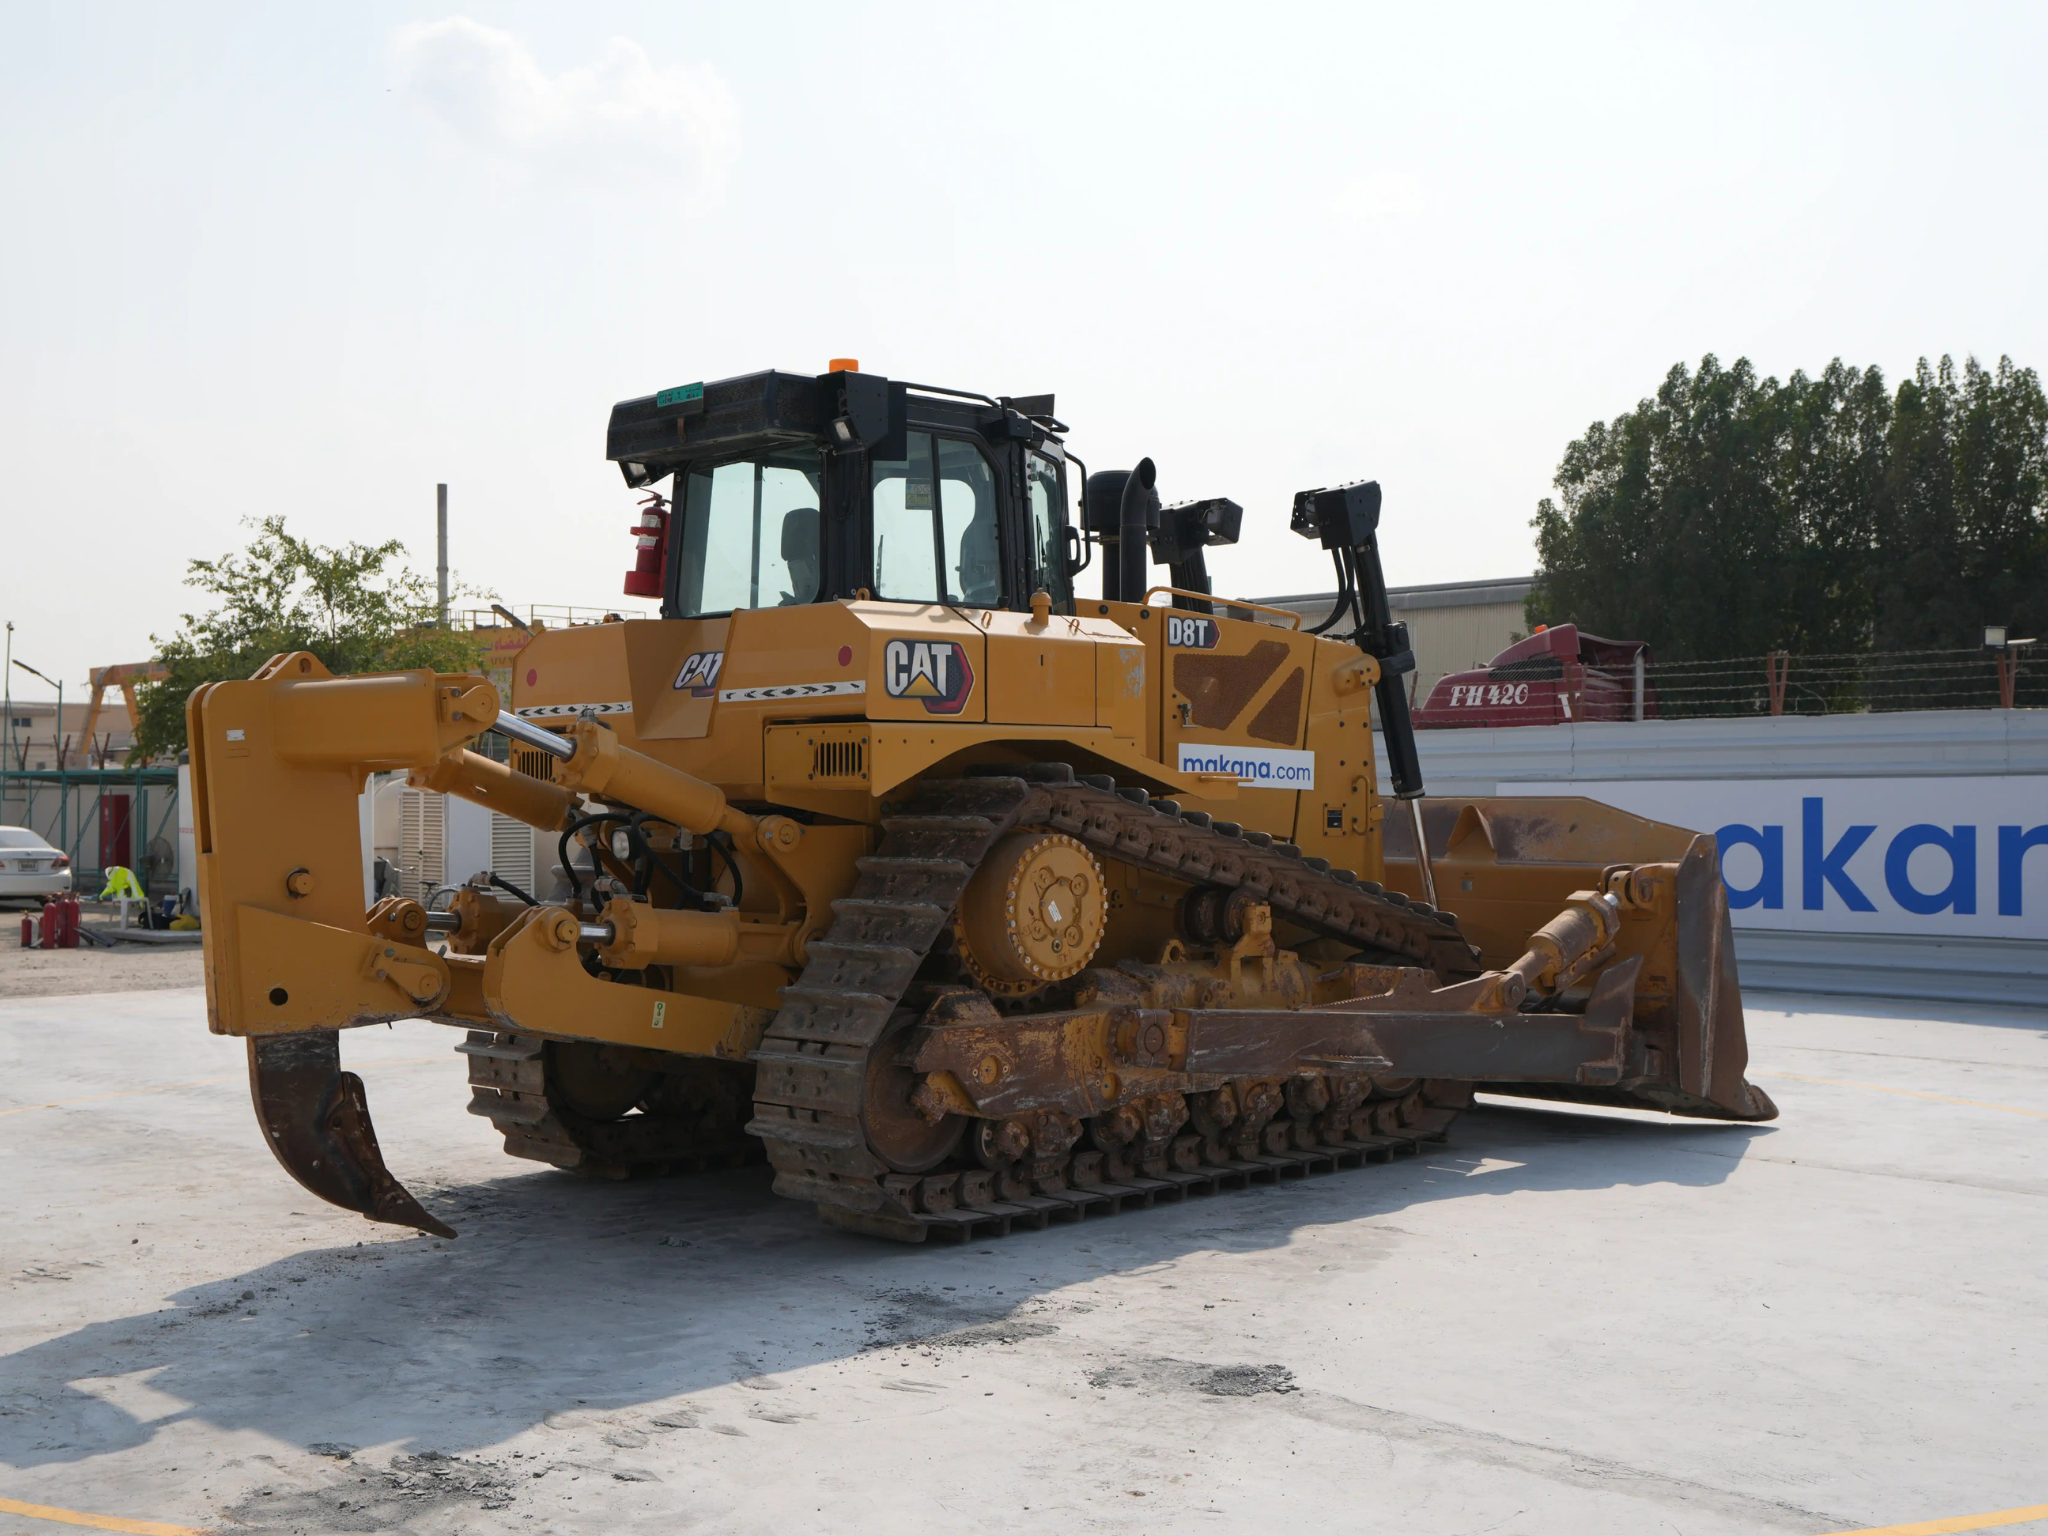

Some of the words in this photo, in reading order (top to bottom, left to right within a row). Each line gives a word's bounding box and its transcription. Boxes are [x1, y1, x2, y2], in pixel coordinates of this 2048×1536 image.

[1169, 617, 1209, 646] D8T
[674, 652, 724, 688] CAT
[886, 640, 952, 697] CAT
[1449, 685, 1485, 707] FH
[1487, 683, 1529, 705] 420
[1183, 754, 1311, 781] makana.com
